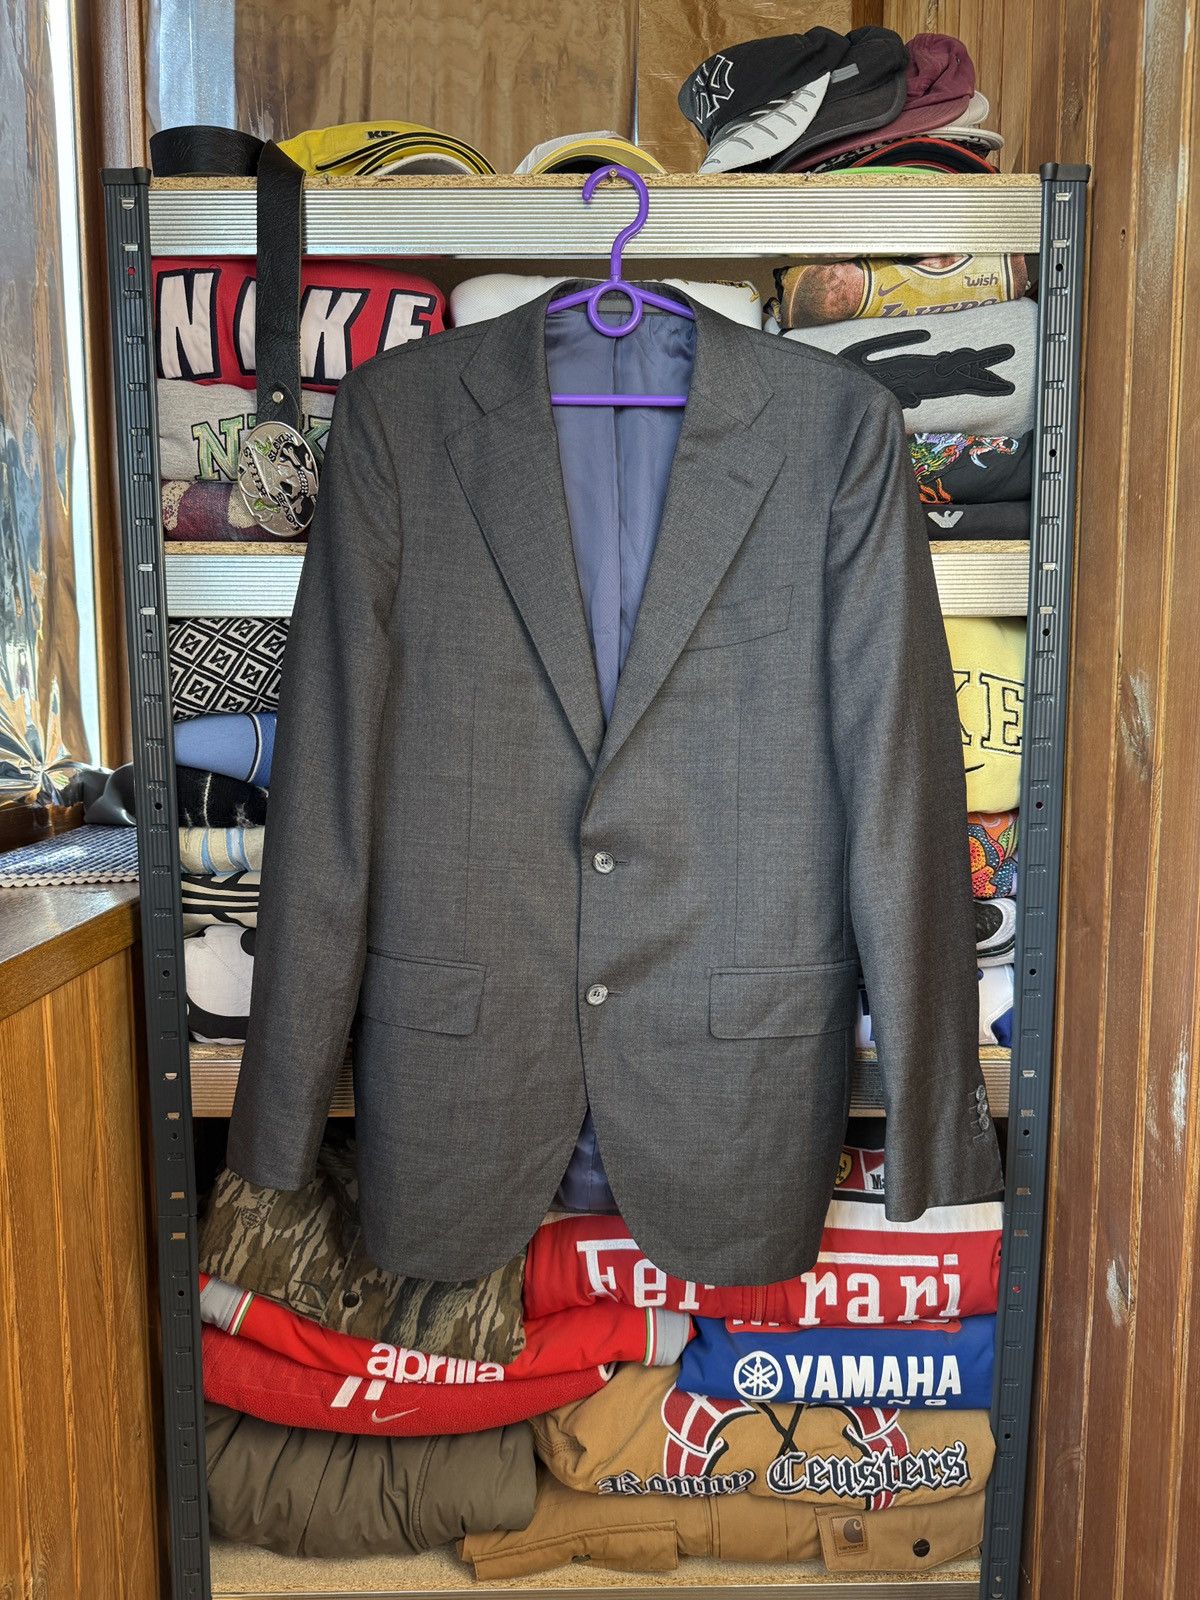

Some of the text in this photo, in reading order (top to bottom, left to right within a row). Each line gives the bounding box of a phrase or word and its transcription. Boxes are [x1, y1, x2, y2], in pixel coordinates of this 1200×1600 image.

[963, 274, 999, 288] wish
[276, 491, 303, 532] LOVE
[785, 1354, 962, 1399] YAMAHA
[766, 1440, 971, 1498] Ceusters
